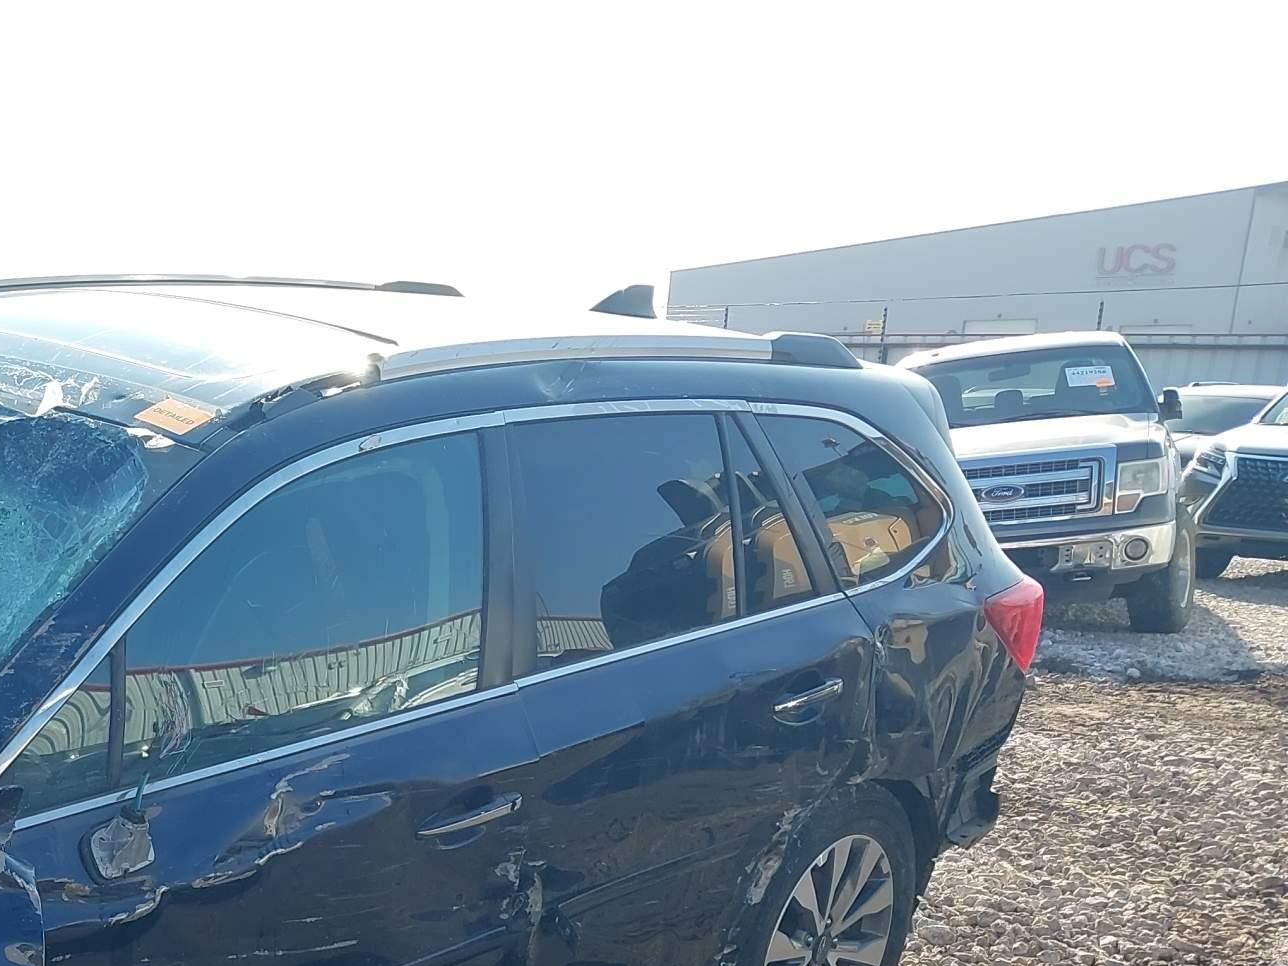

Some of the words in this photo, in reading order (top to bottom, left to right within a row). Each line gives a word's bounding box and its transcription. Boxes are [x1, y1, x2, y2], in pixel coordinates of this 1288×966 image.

[1097, 243, 1176, 274] UCS
[153, 407, 195, 425] DETAILED
[991, 487, 1014, 498] Ford
